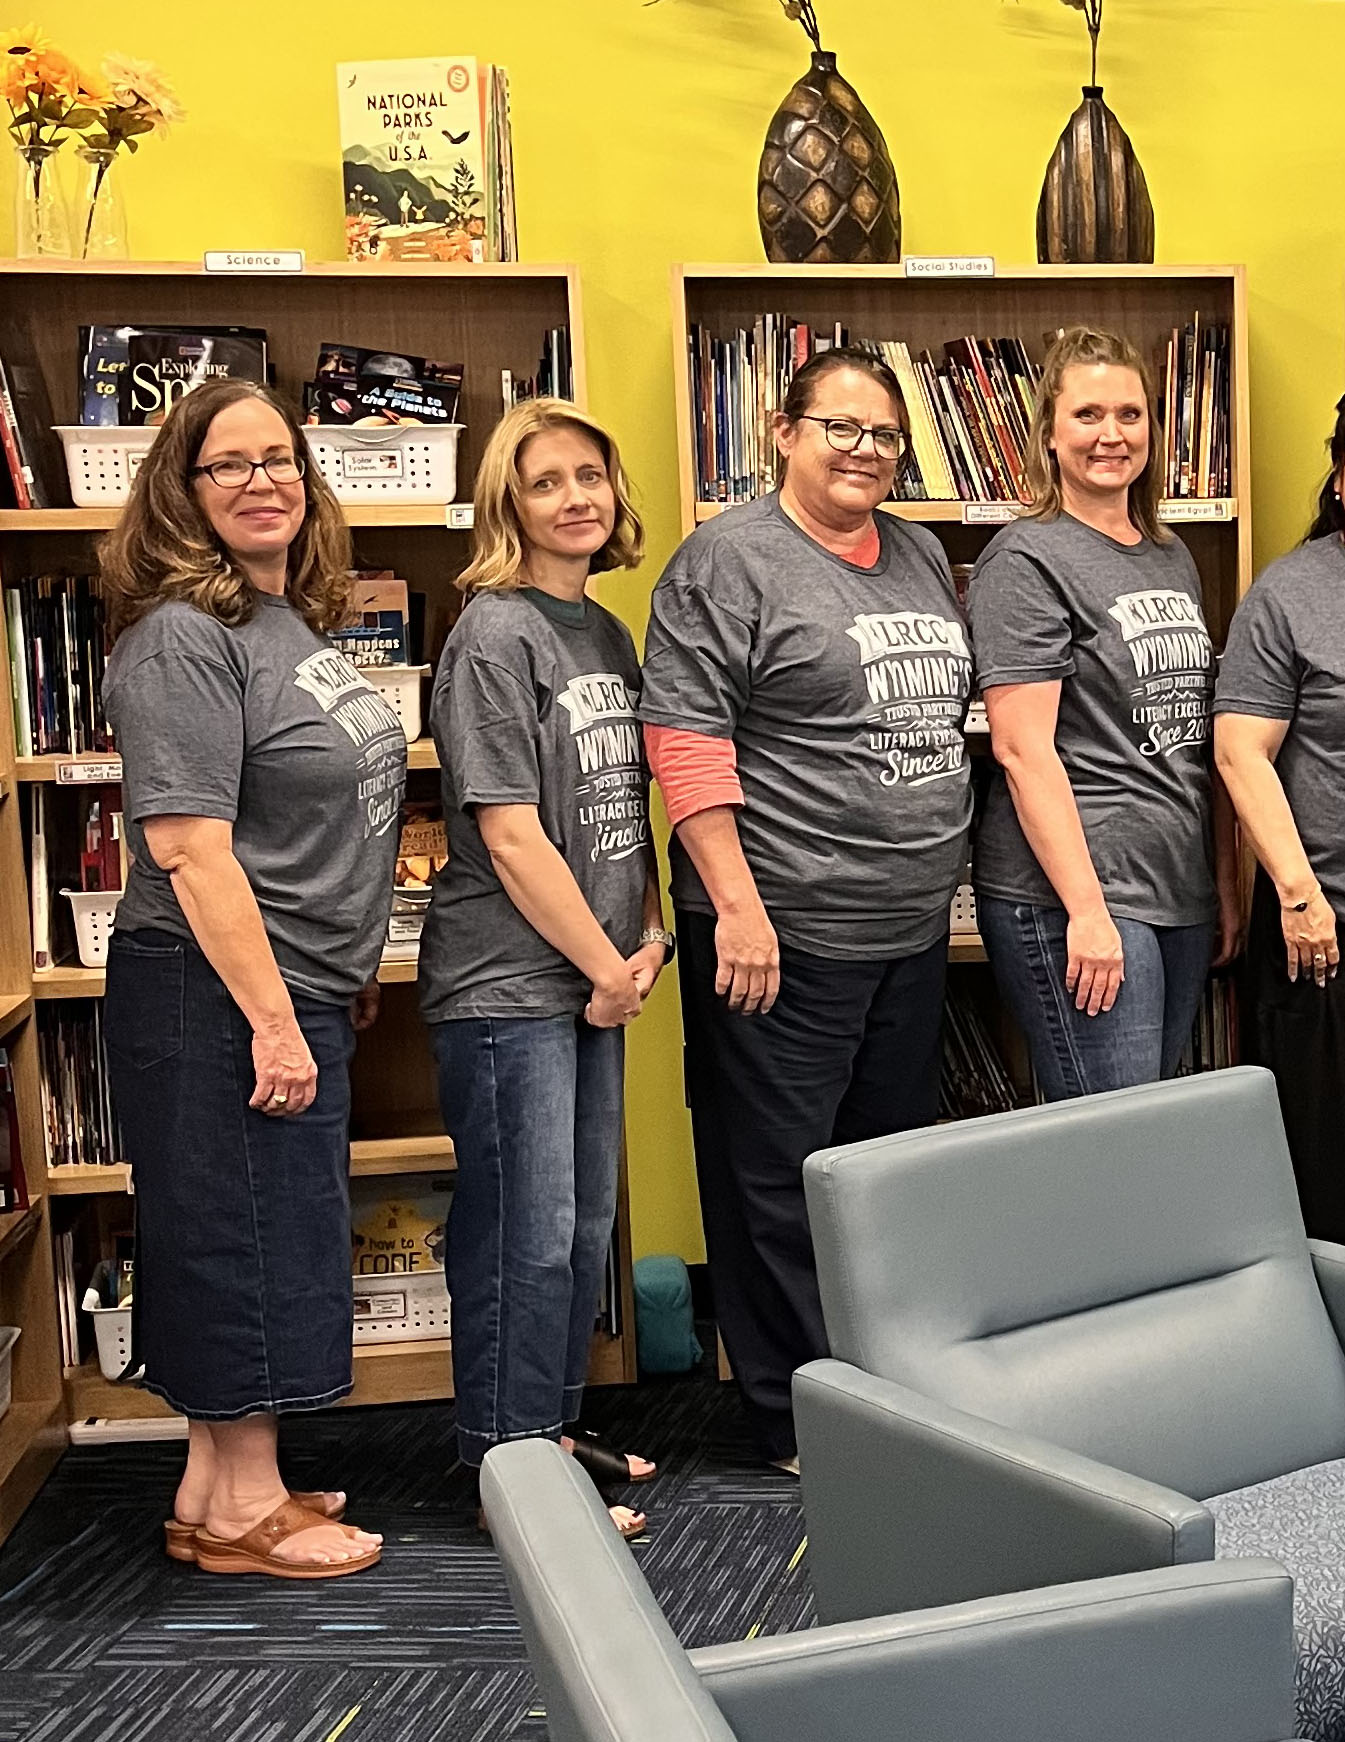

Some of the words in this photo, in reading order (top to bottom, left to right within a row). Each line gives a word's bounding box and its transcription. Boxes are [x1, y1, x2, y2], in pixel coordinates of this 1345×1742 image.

[367, 92, 448, 111] NATIONAL
[383, 111, 433, 128] PARKS
[396, 131, 404, 144] of
[408, 130, 421, 141] the
[388, 145, 433, 161] U.S.A.
[226, 254, 281, 265] Science
[911, 262, 945, 271] Social
[949, 262, 988, 271] Studies
[361, 393, 388, 407] the
[390, 398, 449, 419] Planets
[1140, 597, 1195, 624] LRCC
[877, 619, 949, 647] LRCC
[347, 638, 400, 652] Happens
[1128, 633, 1211, 678] WYOMING
[869, 730, 930, 750] LITERACY
[879, 749, 945, 787] Since
[369, 1238, 397, 1250] how
[401, 1235, 415, 1249] to
